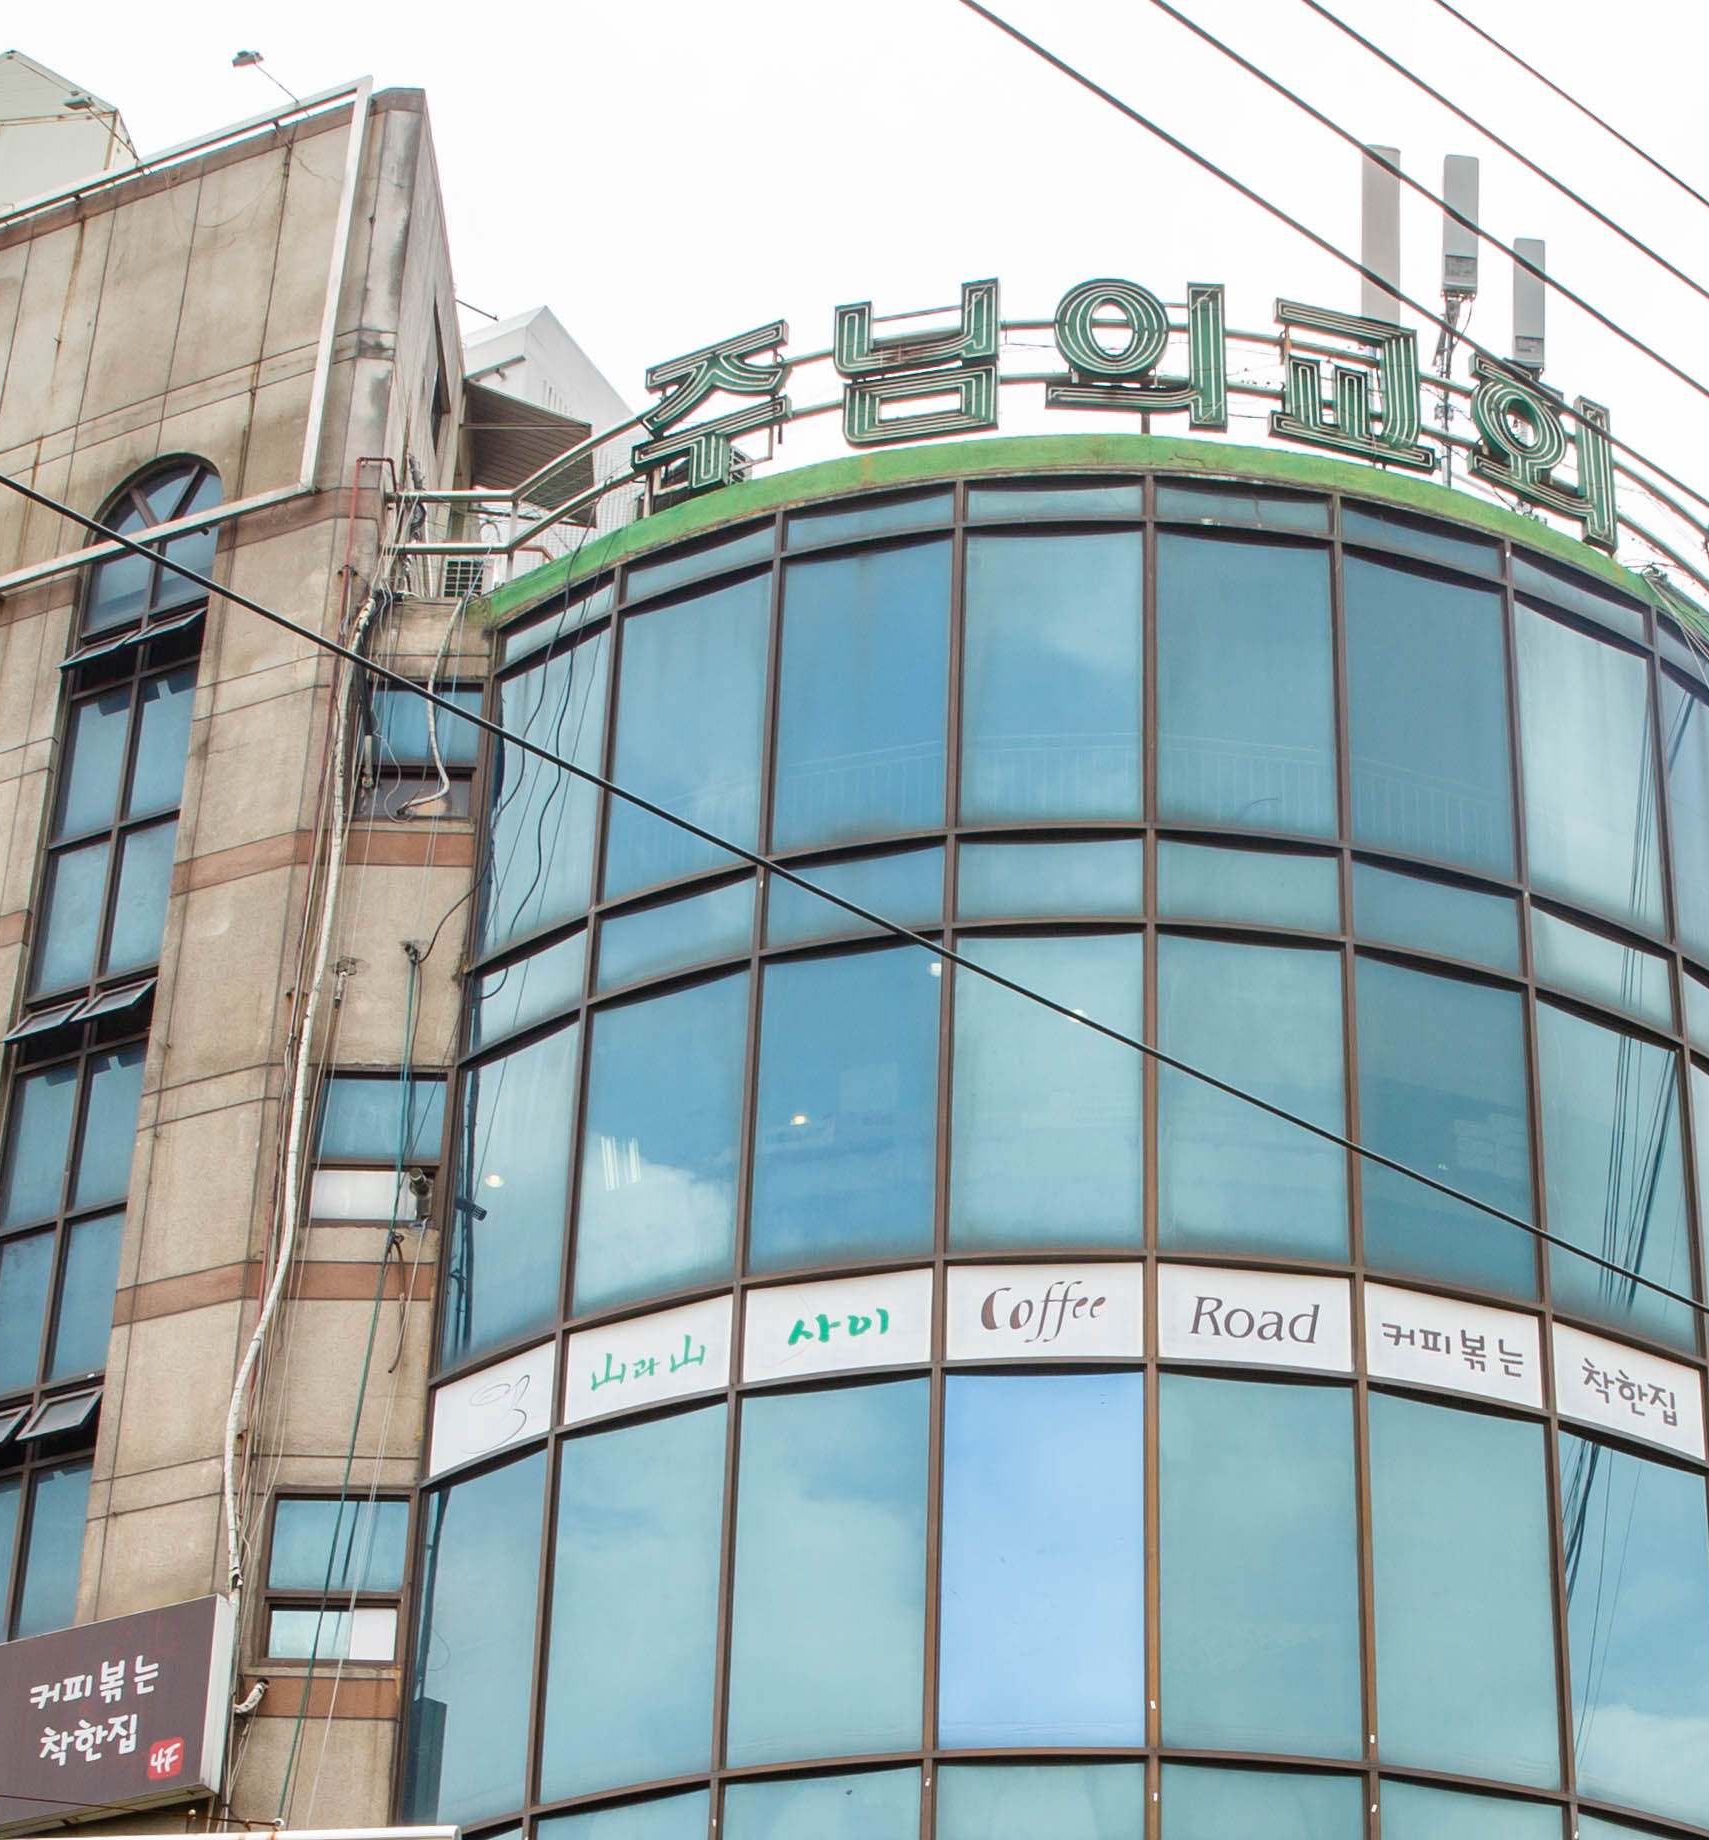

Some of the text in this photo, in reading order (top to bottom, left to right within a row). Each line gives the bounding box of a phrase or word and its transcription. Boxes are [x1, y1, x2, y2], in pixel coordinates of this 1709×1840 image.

[788, 1308, 889, 1348] 사이
[981, 1280, 1106, 1343] Coffee
[1191, 1295, 1320, 1345] Road
[40, 1714, 138, 1766] 착한집
[150, 1742, 181, 1773] 4F
